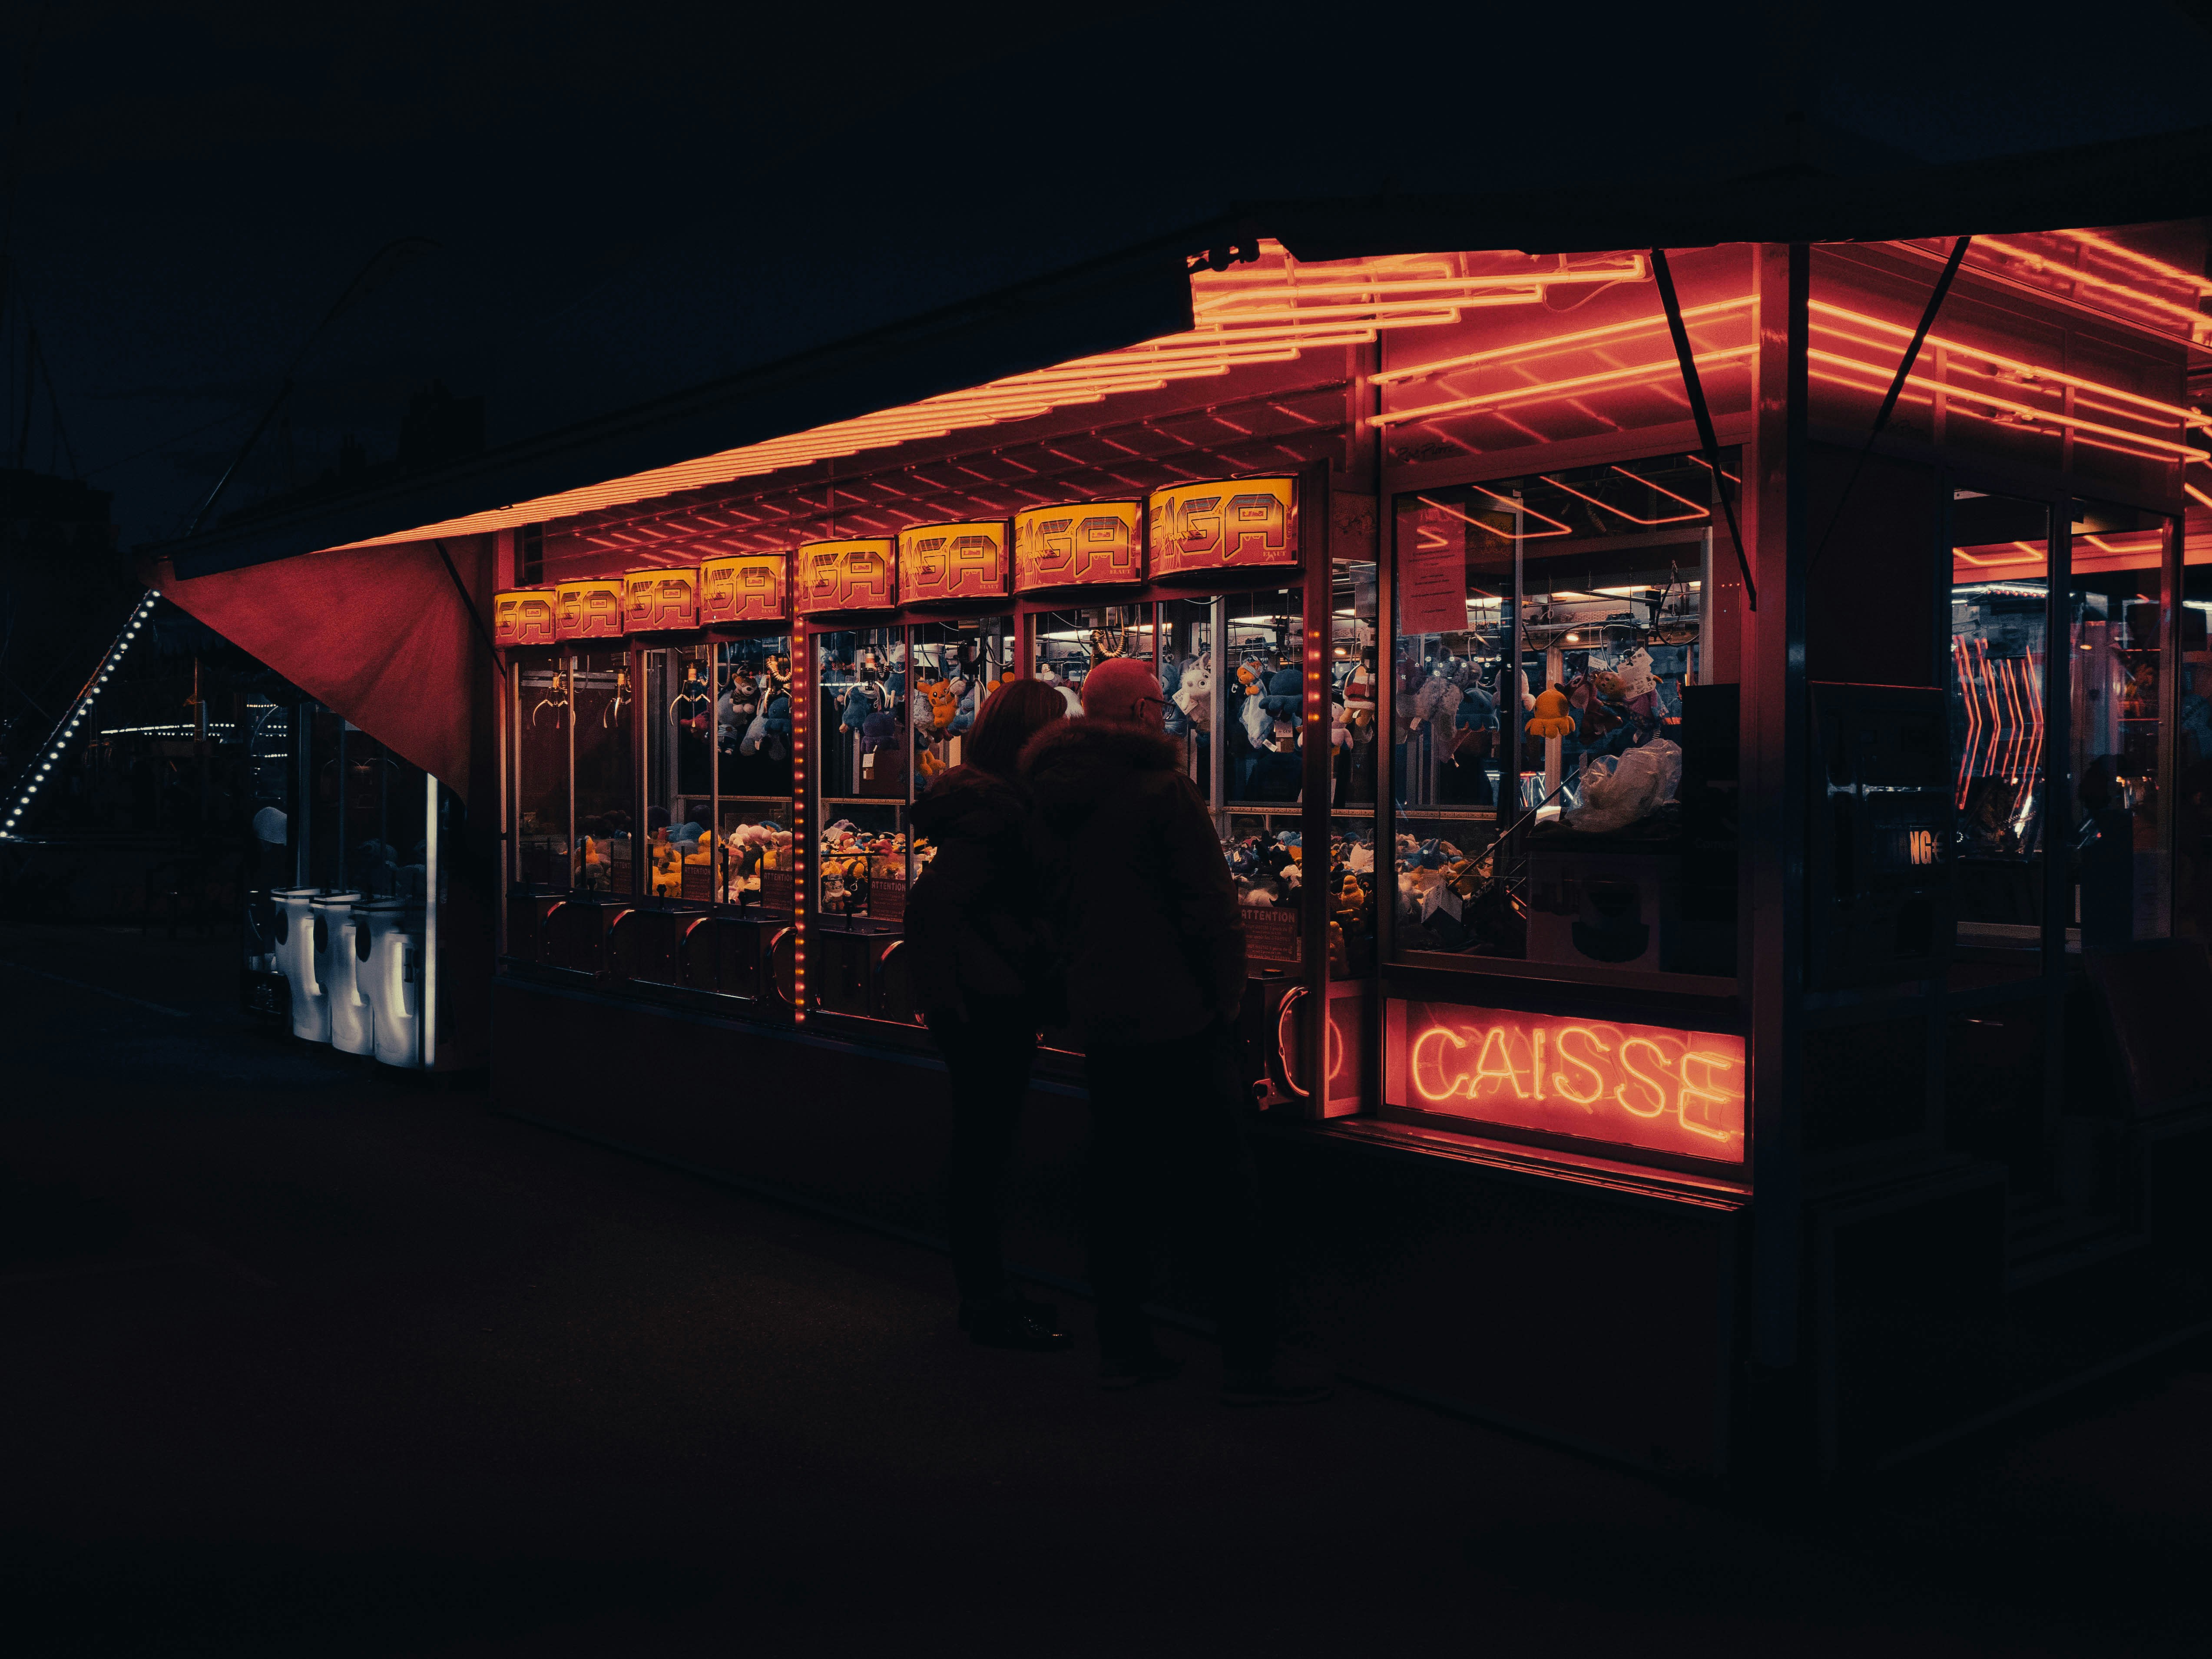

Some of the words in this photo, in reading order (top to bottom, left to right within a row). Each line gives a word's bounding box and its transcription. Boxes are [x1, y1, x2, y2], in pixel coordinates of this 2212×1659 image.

[871, 881, 906, 892] ATTENTION
[1241, 909, 1295, 923] ATTENTION
[1412, 1026, 1733, 1143] CAISSE
